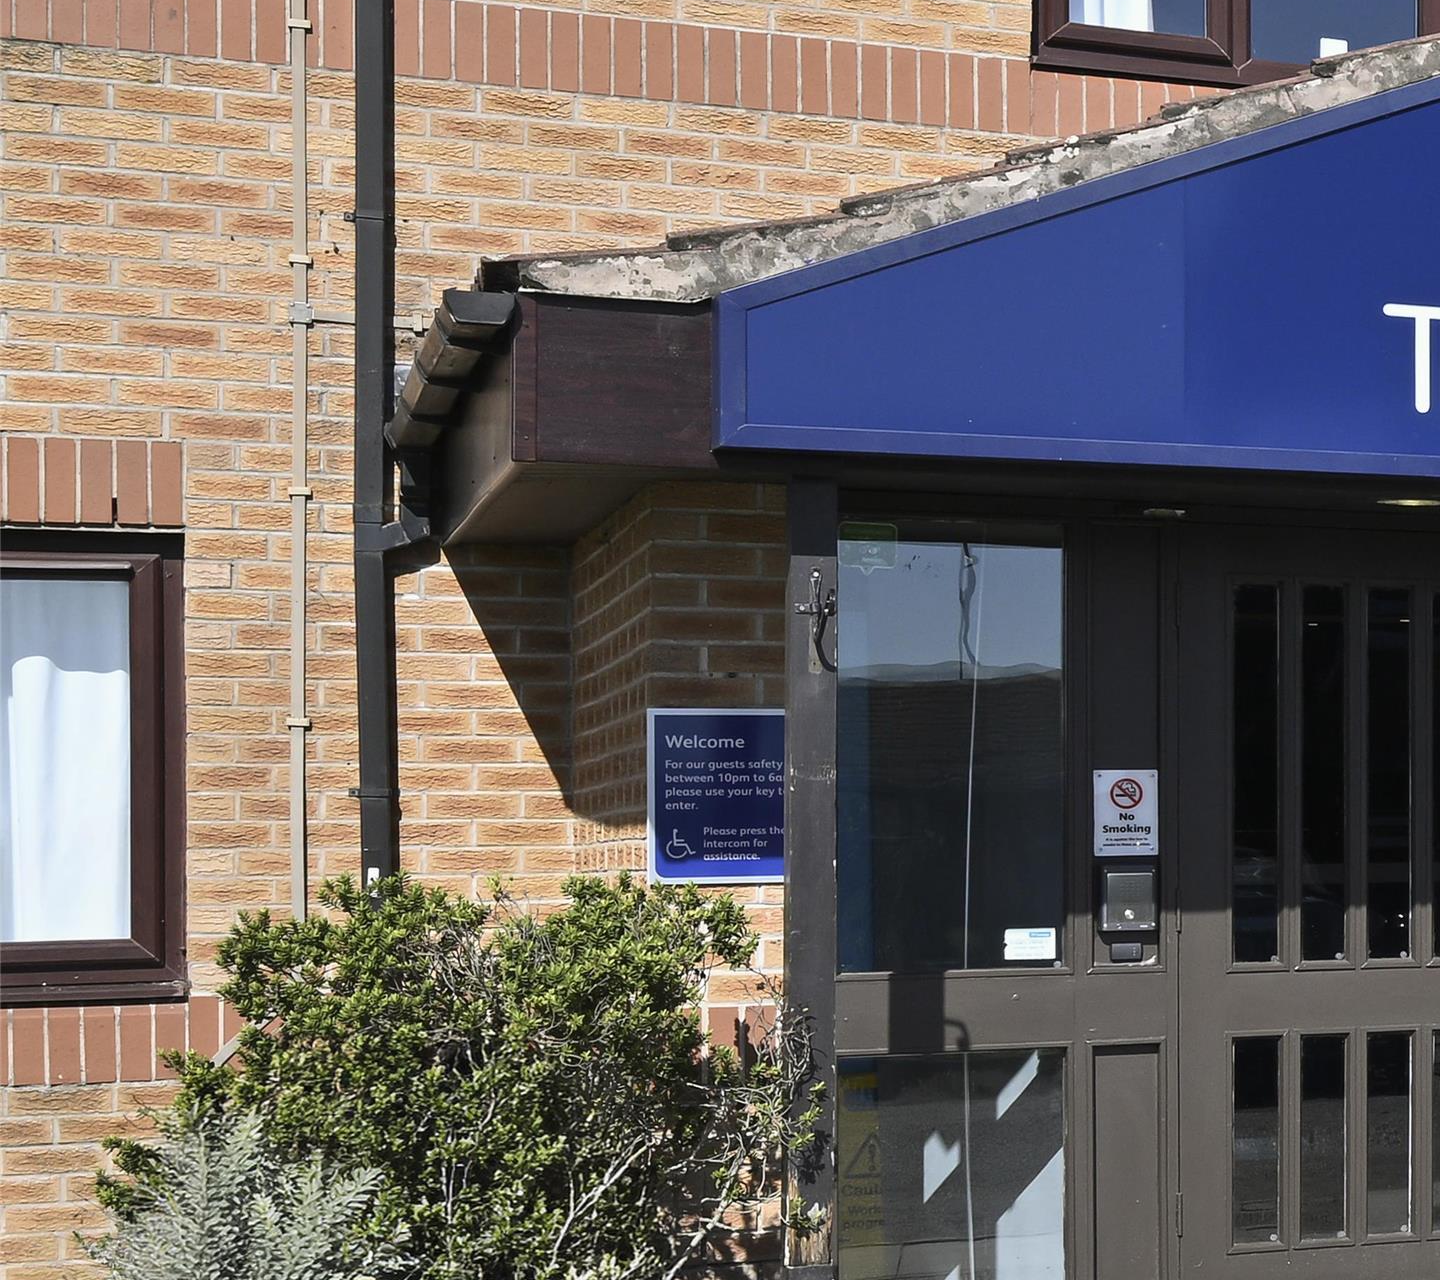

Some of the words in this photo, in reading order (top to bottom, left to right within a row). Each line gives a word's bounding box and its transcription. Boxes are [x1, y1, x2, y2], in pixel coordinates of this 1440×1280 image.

[665, 735, 745, 749] Welcome
[665, 759, 683, 769] For
[686, 761, 705, 769] our
[708, 760, 745, 771] guests
[748, 759, 783, 771] safety
[665, 773, 714, 783] between
[718, 772, 750, 784] 10pm
[753, 773, 765, 783] to
[768, 772, 785, 783] 6a
[665, 786, 702, 798] please
[705, 788, 725, 797] use
[728, 788, 752, 798] your
[756, 786, 775, 798] key
[778, 787, 785, 797] t
[665, 801, 699, 811] enter.
[1119, 812, 1135, 821] No
[703, 826, 737, 836] Please
[740, 827, 766, 837] press
[1102, 823, 1151, 835] Smoking
[703, 838, 751, 848] intercom
[753, 838, 768, 848] for
[703, 851, 761, 861] assistance.
